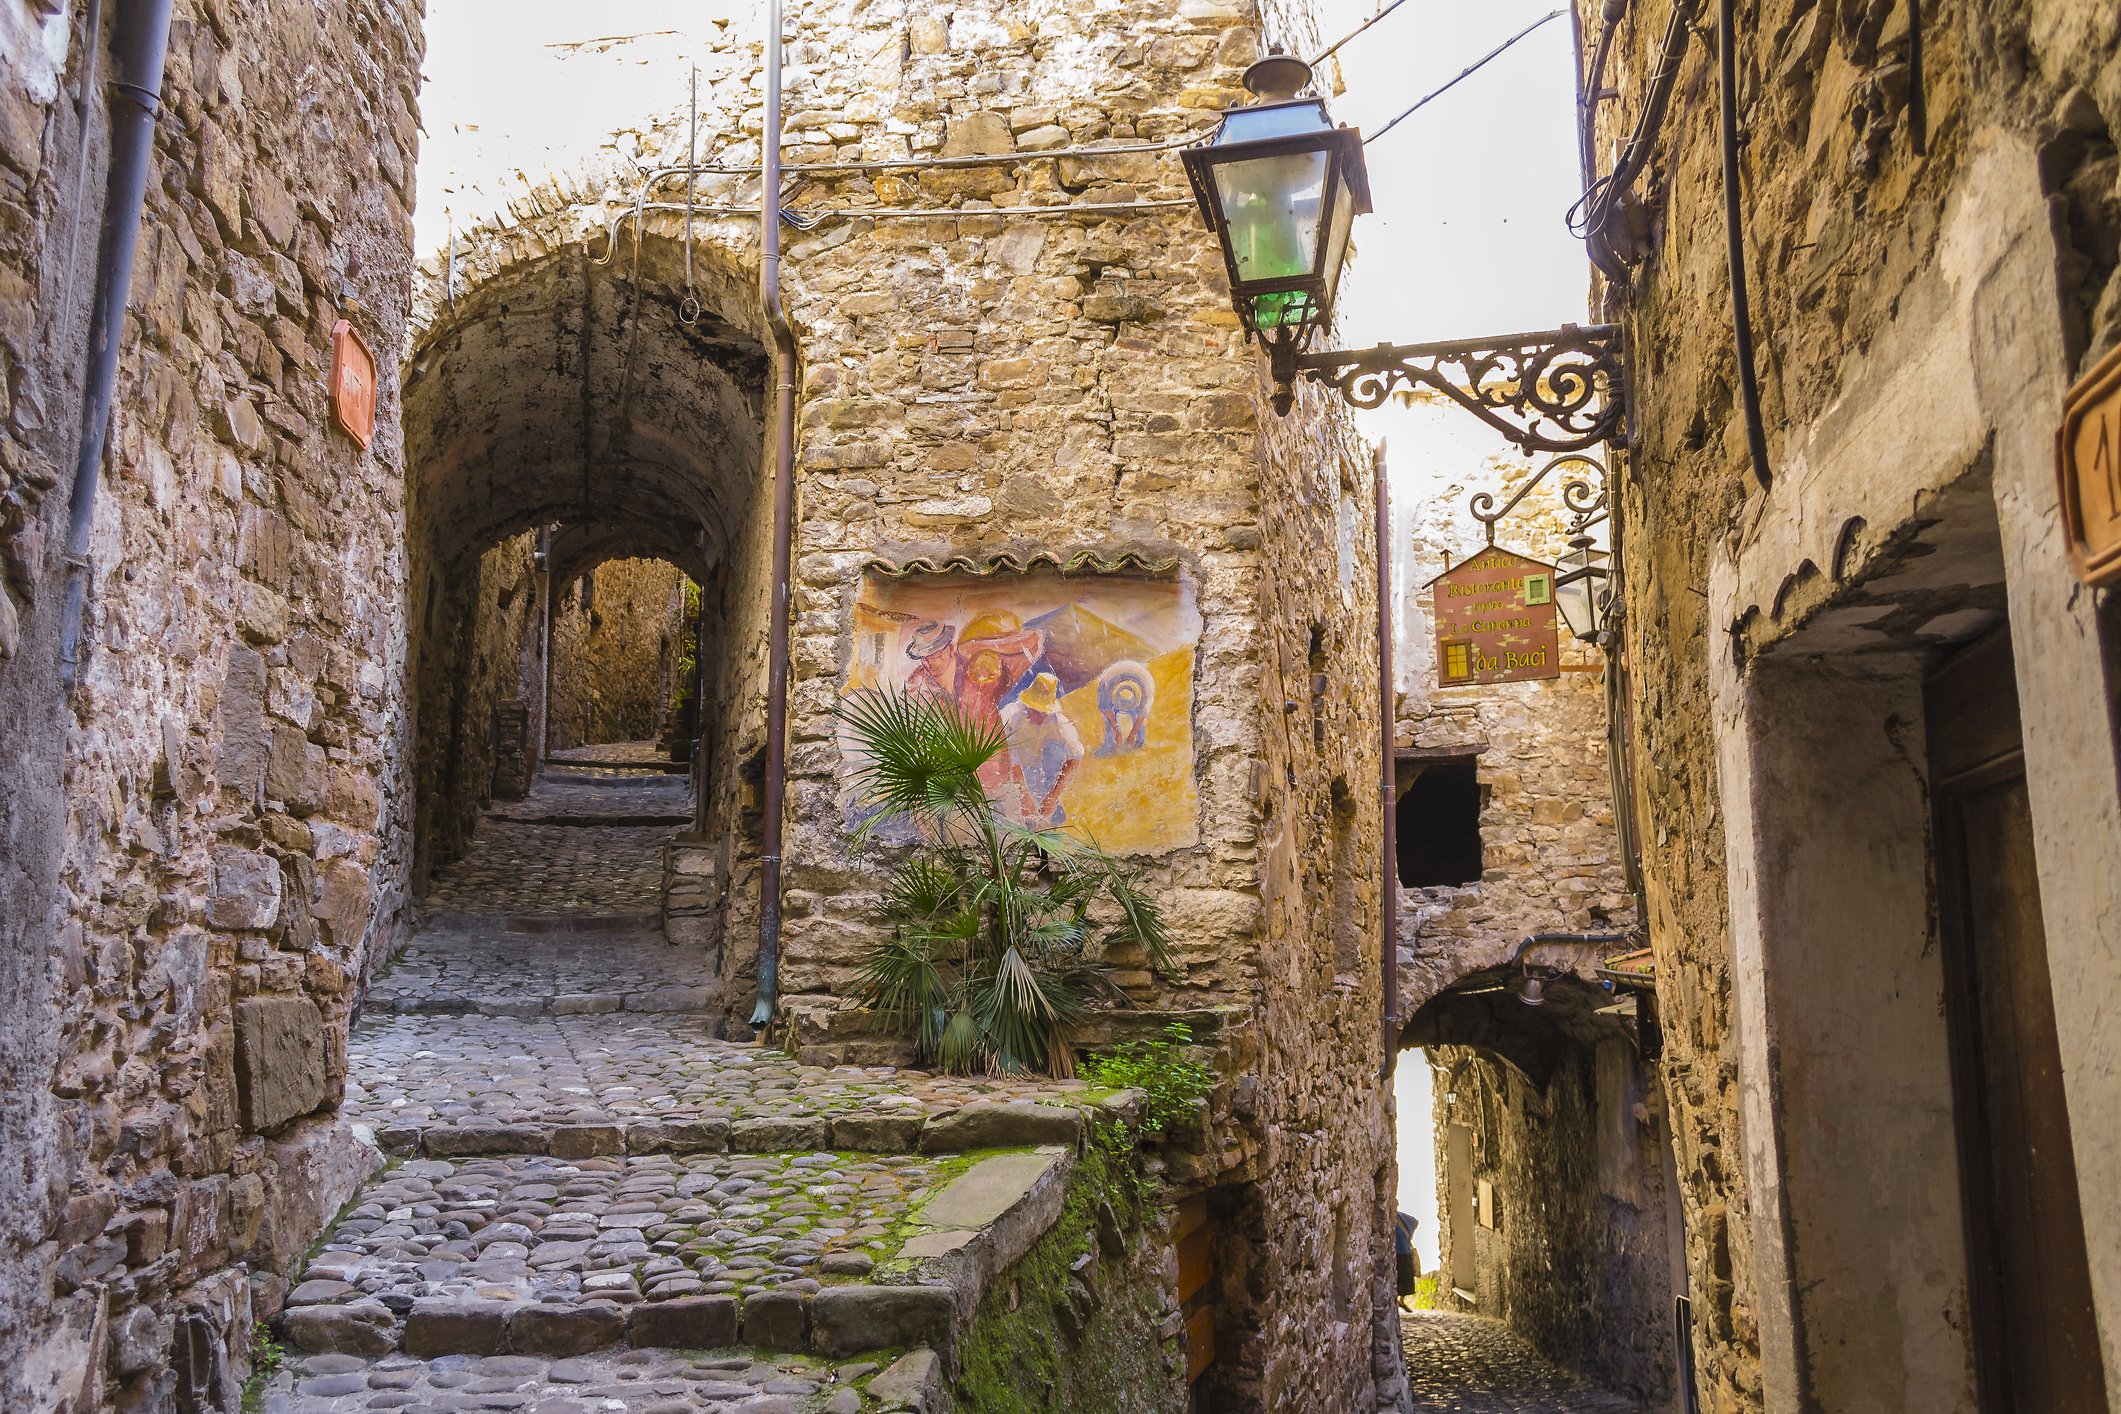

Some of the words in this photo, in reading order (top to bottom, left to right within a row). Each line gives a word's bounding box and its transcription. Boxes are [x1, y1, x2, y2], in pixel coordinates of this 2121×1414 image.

[2093, 412, 2121, 522] 1
[1469, 556, 1517, 572] Antico
[1448, 577, 1524, 598] Ristorante
[1450, 623, 1469, 635] La
[1472, 617, 1532, 637] Capanna
[1476, 651, 1498, 672] da
[1505, 645, 1547, 669] Baci
